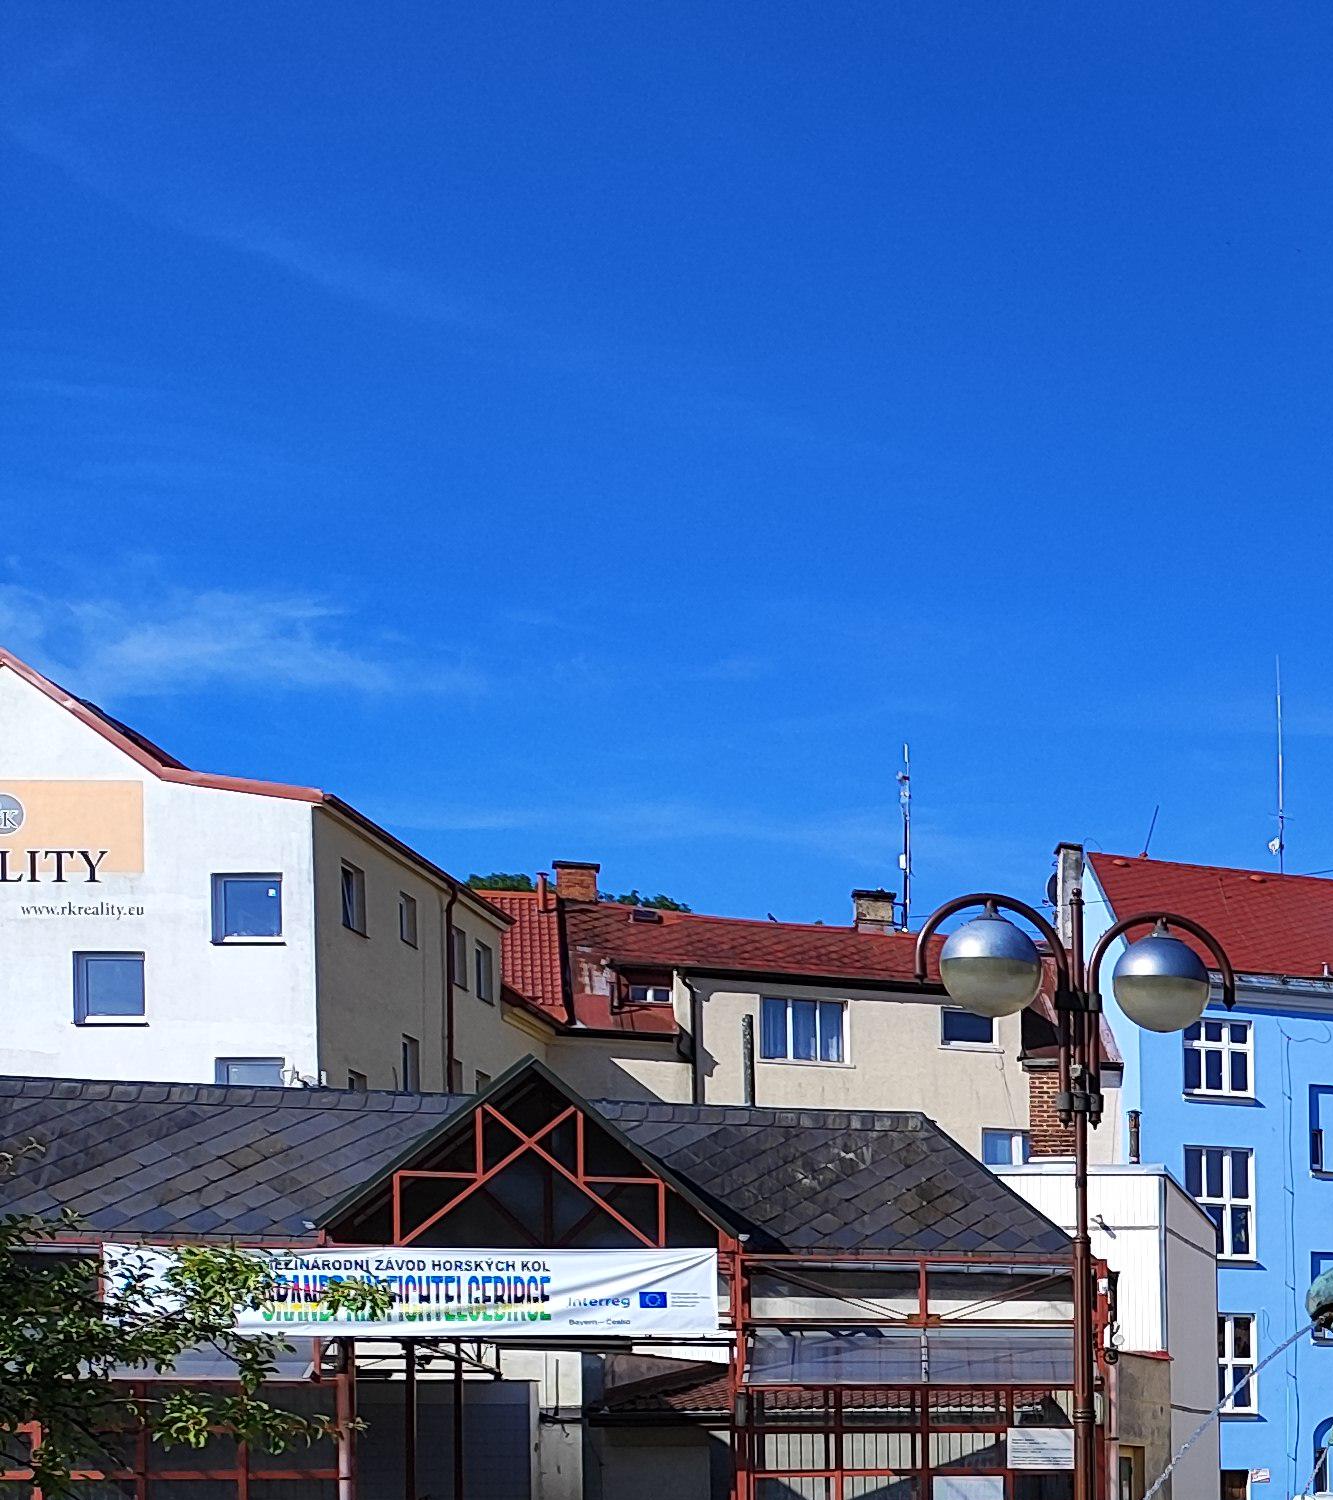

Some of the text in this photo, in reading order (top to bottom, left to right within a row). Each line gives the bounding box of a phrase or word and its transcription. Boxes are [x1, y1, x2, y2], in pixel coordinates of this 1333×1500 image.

[20, 901, 145, 920] www.rkreality.eu
[375, 1256, 426, 1271] ZÁVOD
[432, 1258, 516, 1272] HORSKÝCH
[521, 1260, 551, 1272] KOL
[568, 1297, 631, 1308] Interreg
